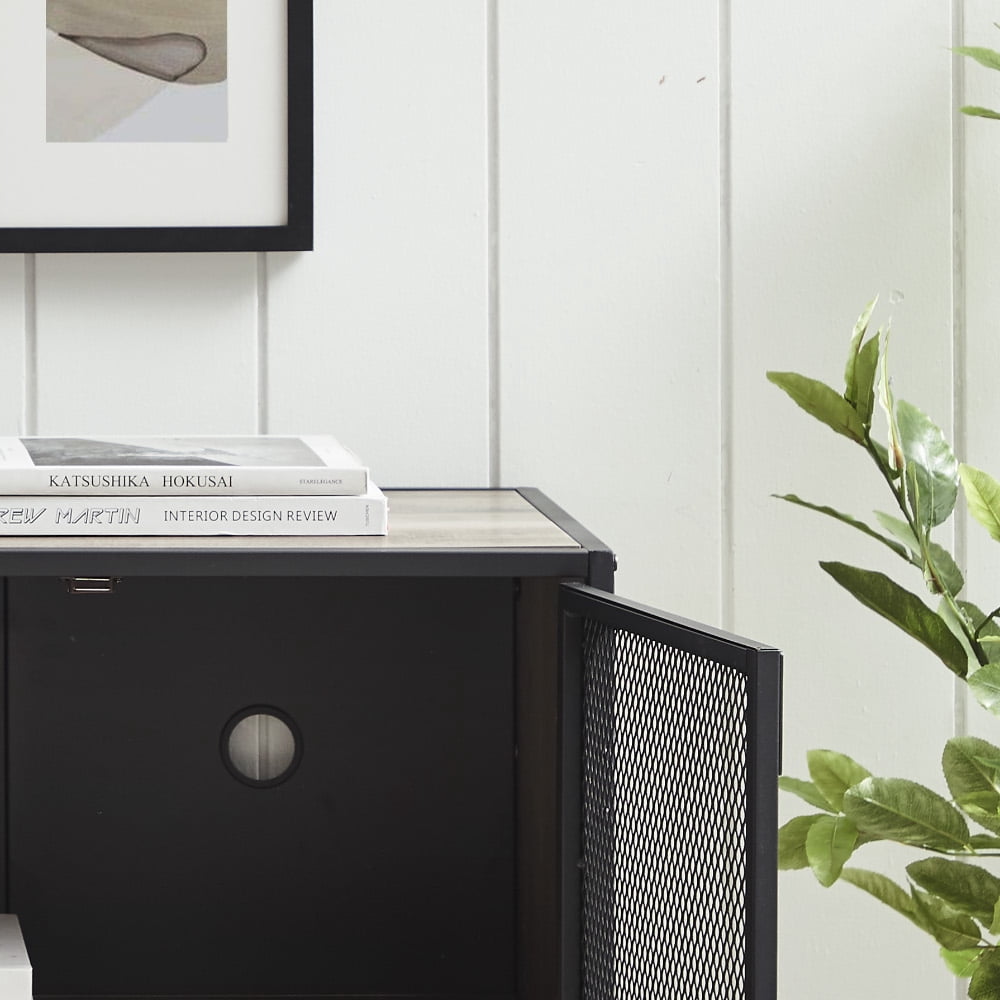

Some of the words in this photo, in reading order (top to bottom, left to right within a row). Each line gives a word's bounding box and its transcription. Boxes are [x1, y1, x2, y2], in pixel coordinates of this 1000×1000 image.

[49, 475, 150, 488] KATSUSHIKA
[162, 475, 233, 488] HOKUSAI
[55, 508, 141, 524] MARTIN
[164, 510, 228, 522] INTERIOR
[232, 510, 282, 522] DESIGN
[287, 510, 338, 522] REVIEW
